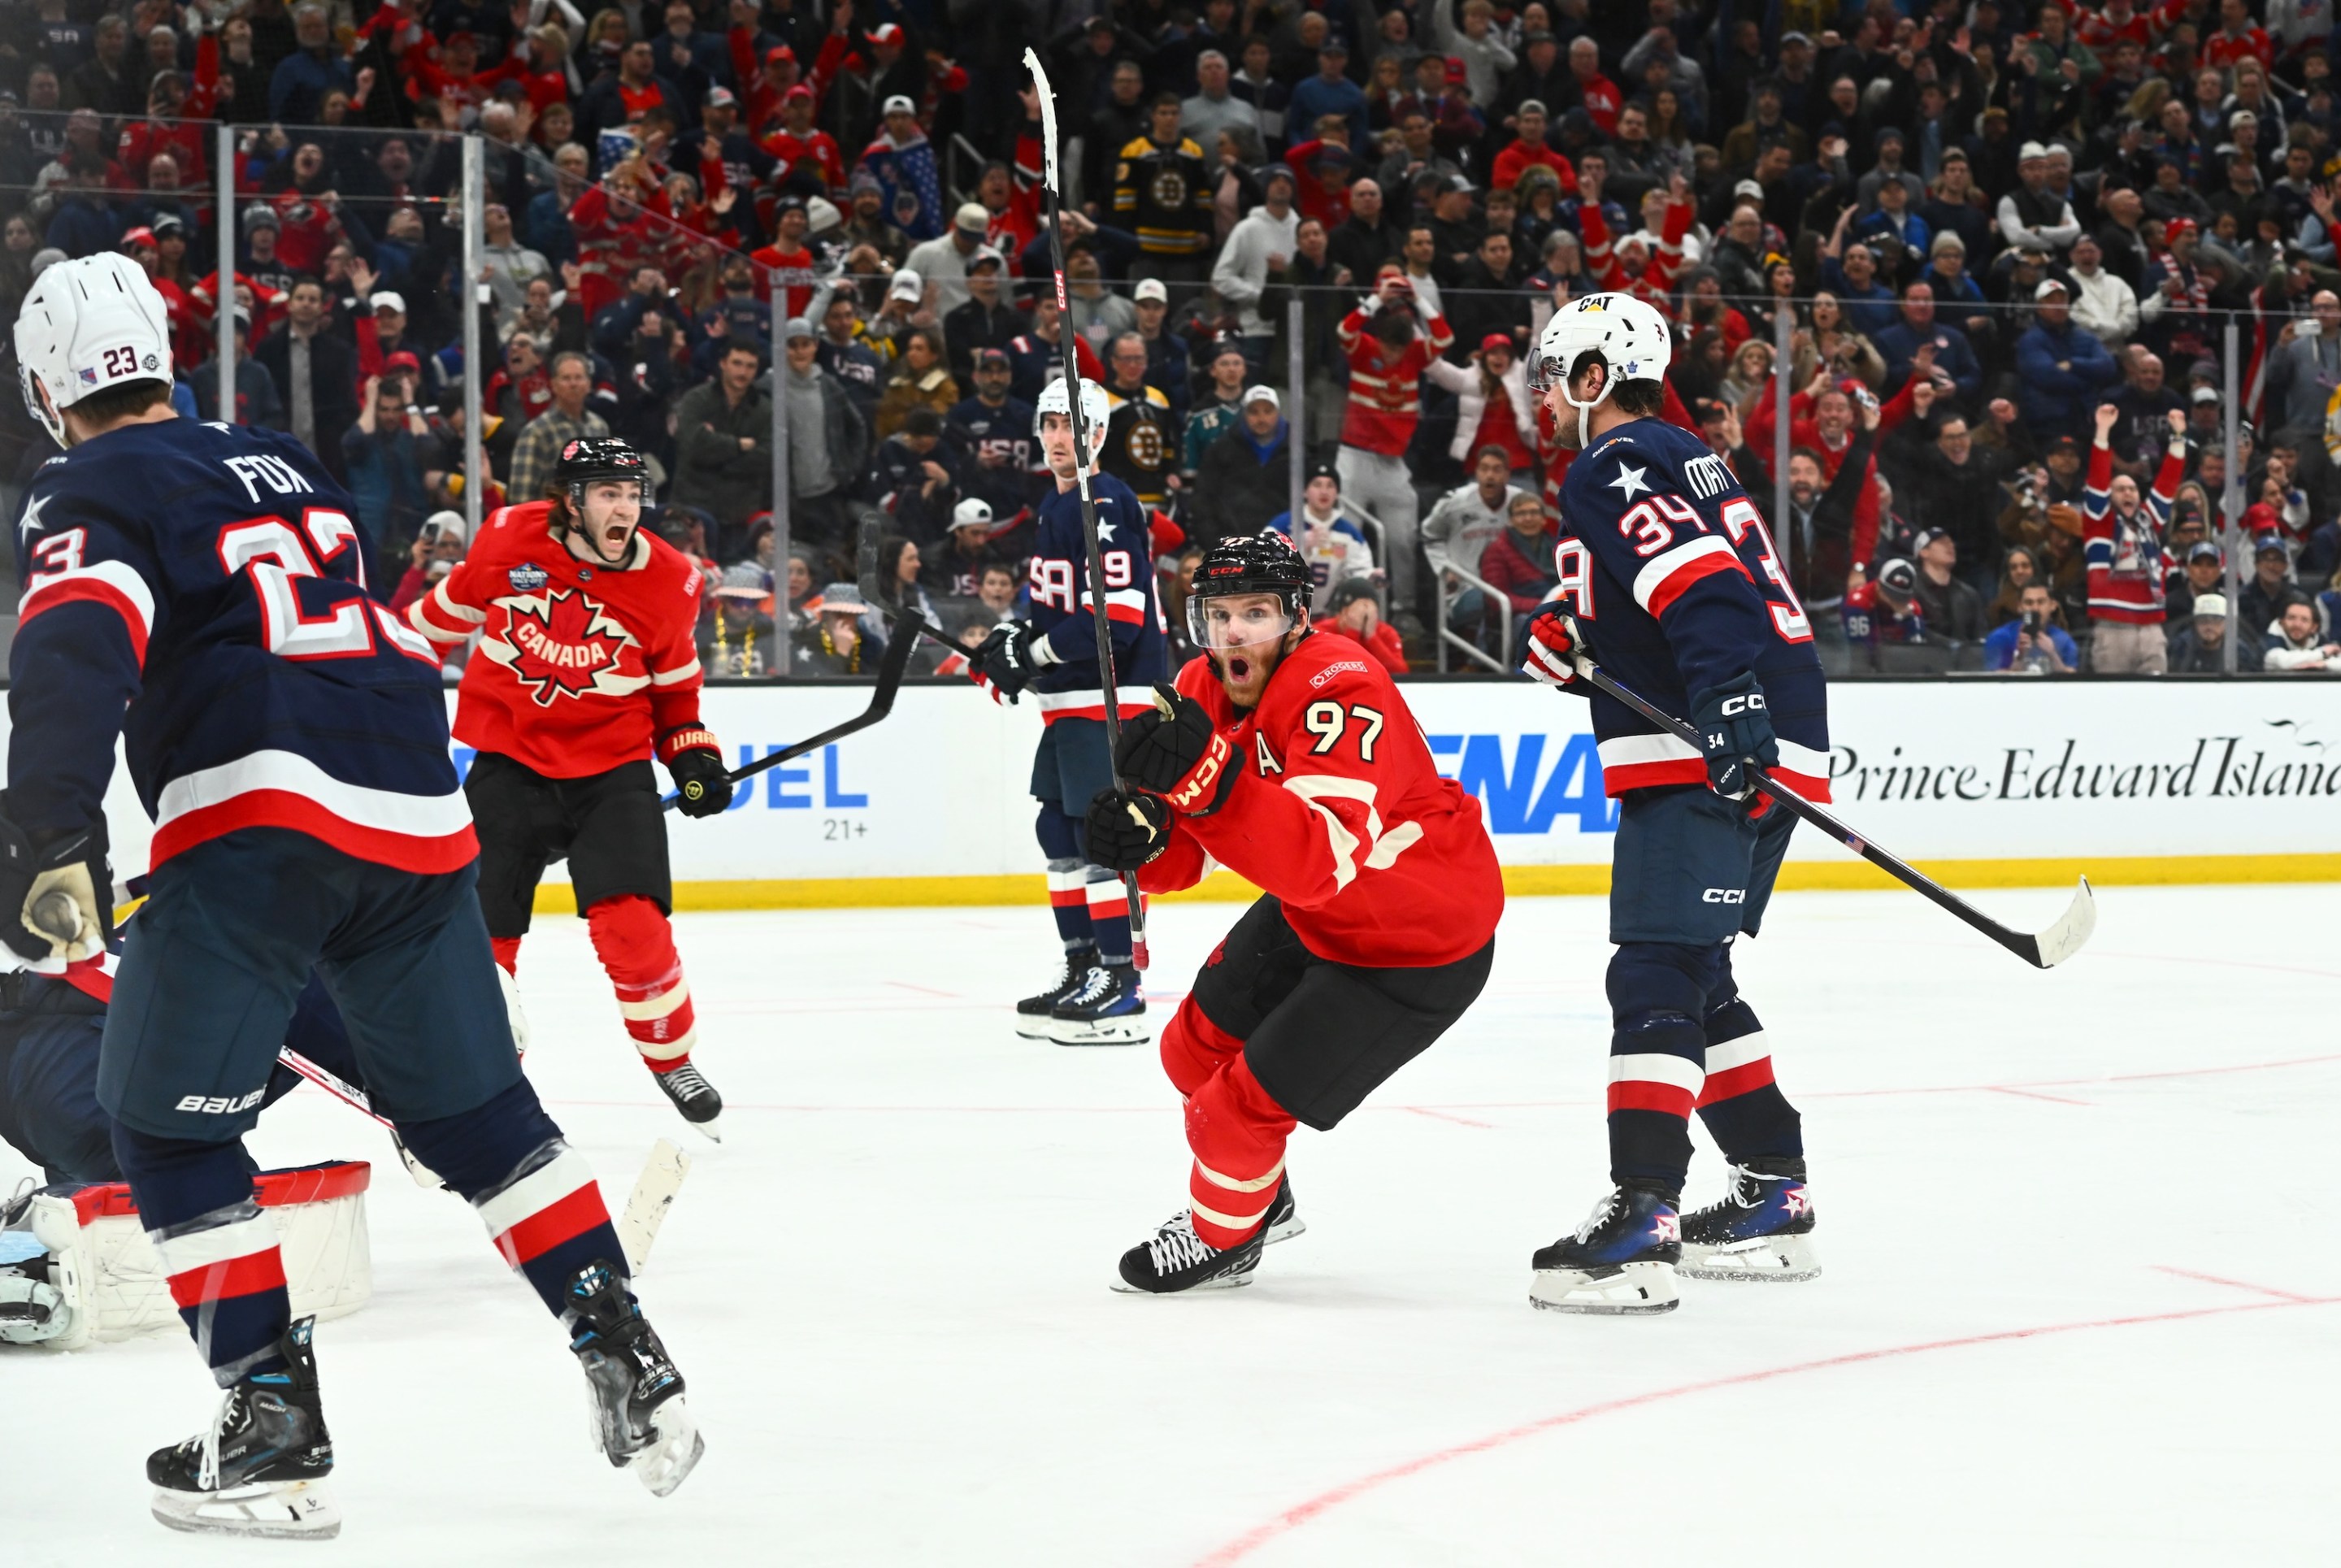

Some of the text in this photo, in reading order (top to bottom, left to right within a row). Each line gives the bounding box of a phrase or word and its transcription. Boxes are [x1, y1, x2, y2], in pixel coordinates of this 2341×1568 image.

[1055, 272, 1066, 309] CCM
[1578, 296, 1614, 312] CAT
[103, 345, 138, 378] 23
[224, 454, 313, 503] FOX
[1618, 494, 1709, 557] 34
[1210, 566, 1245, 576] CCM
[1848, 615, 1870, 636] 96
[517, 622, 607, 668] CANADA
[1324, 662, 1363, 678] ROGERS
[1722, 693, 1766, 716] CC
[1305, 701, 1383, 764] 97
[1708, 732, 1724, 749] 34
[1256, 729, 1284, 777] A
[1175, 733, 1227, 806] CCM
[1720, 763, 1735, 784] CCM
[1829, 745, 1991, 801] Prince
[1996, 738, 2206, 801] Edward
[823, 819, 867, 840] 21+
[1145, 846, 1165, 864] CCM
